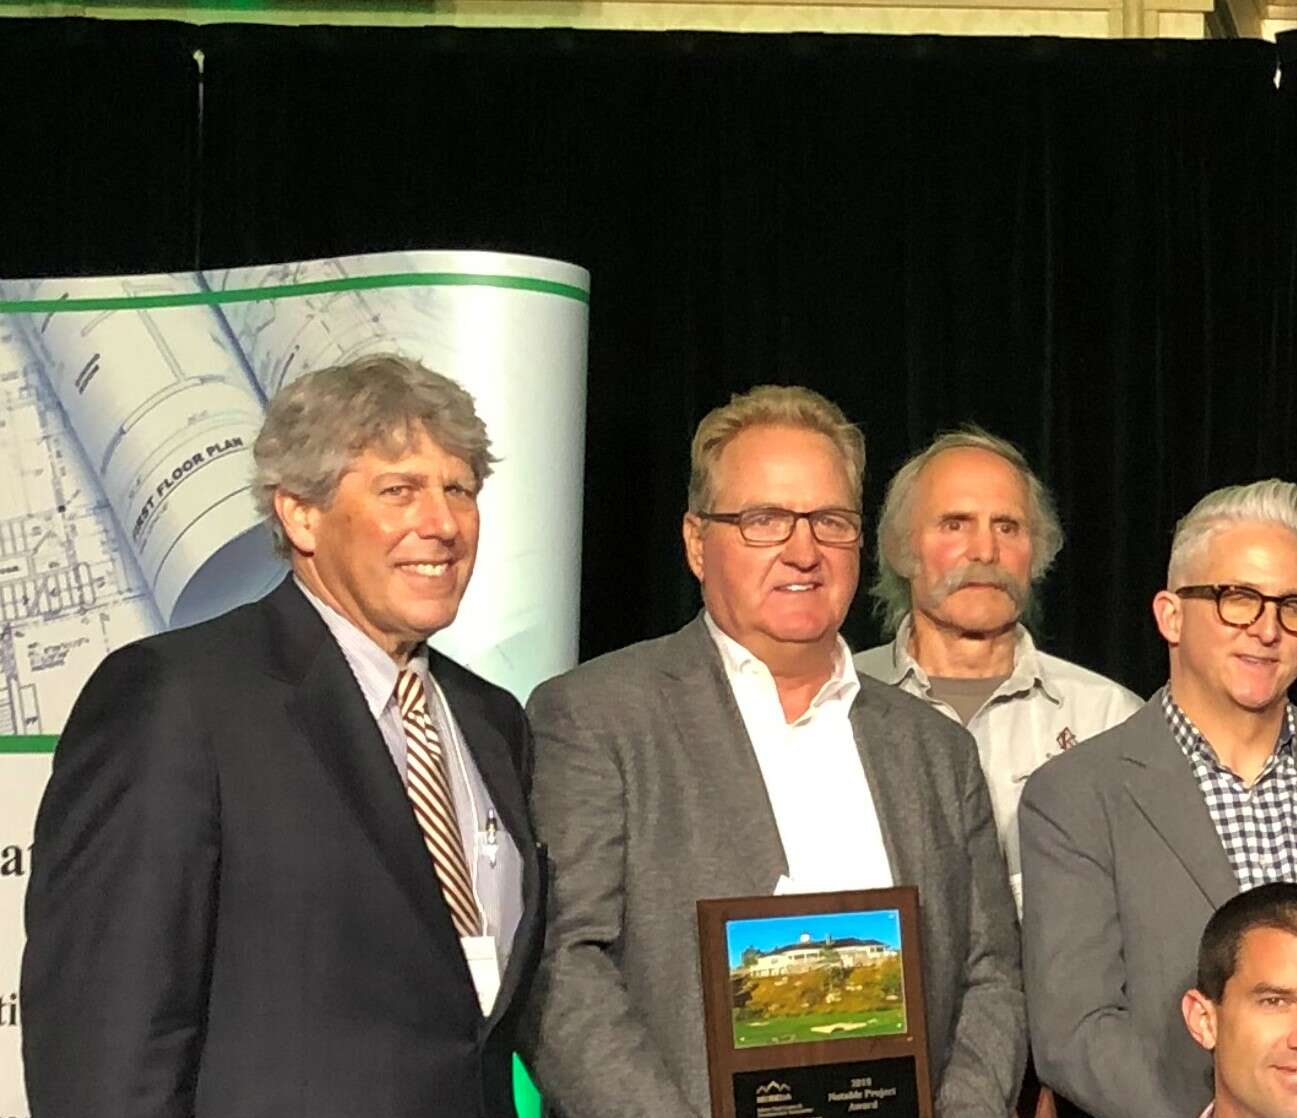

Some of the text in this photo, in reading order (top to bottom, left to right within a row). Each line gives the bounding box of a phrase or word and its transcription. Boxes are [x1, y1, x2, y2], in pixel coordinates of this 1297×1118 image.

[156, 452, 205, 498] FLOOR
[205, 437, 244, 457] PLAN
[828, 1087, 896, 1102] Notable Project
[848, 1100, 878, 1112] Award
